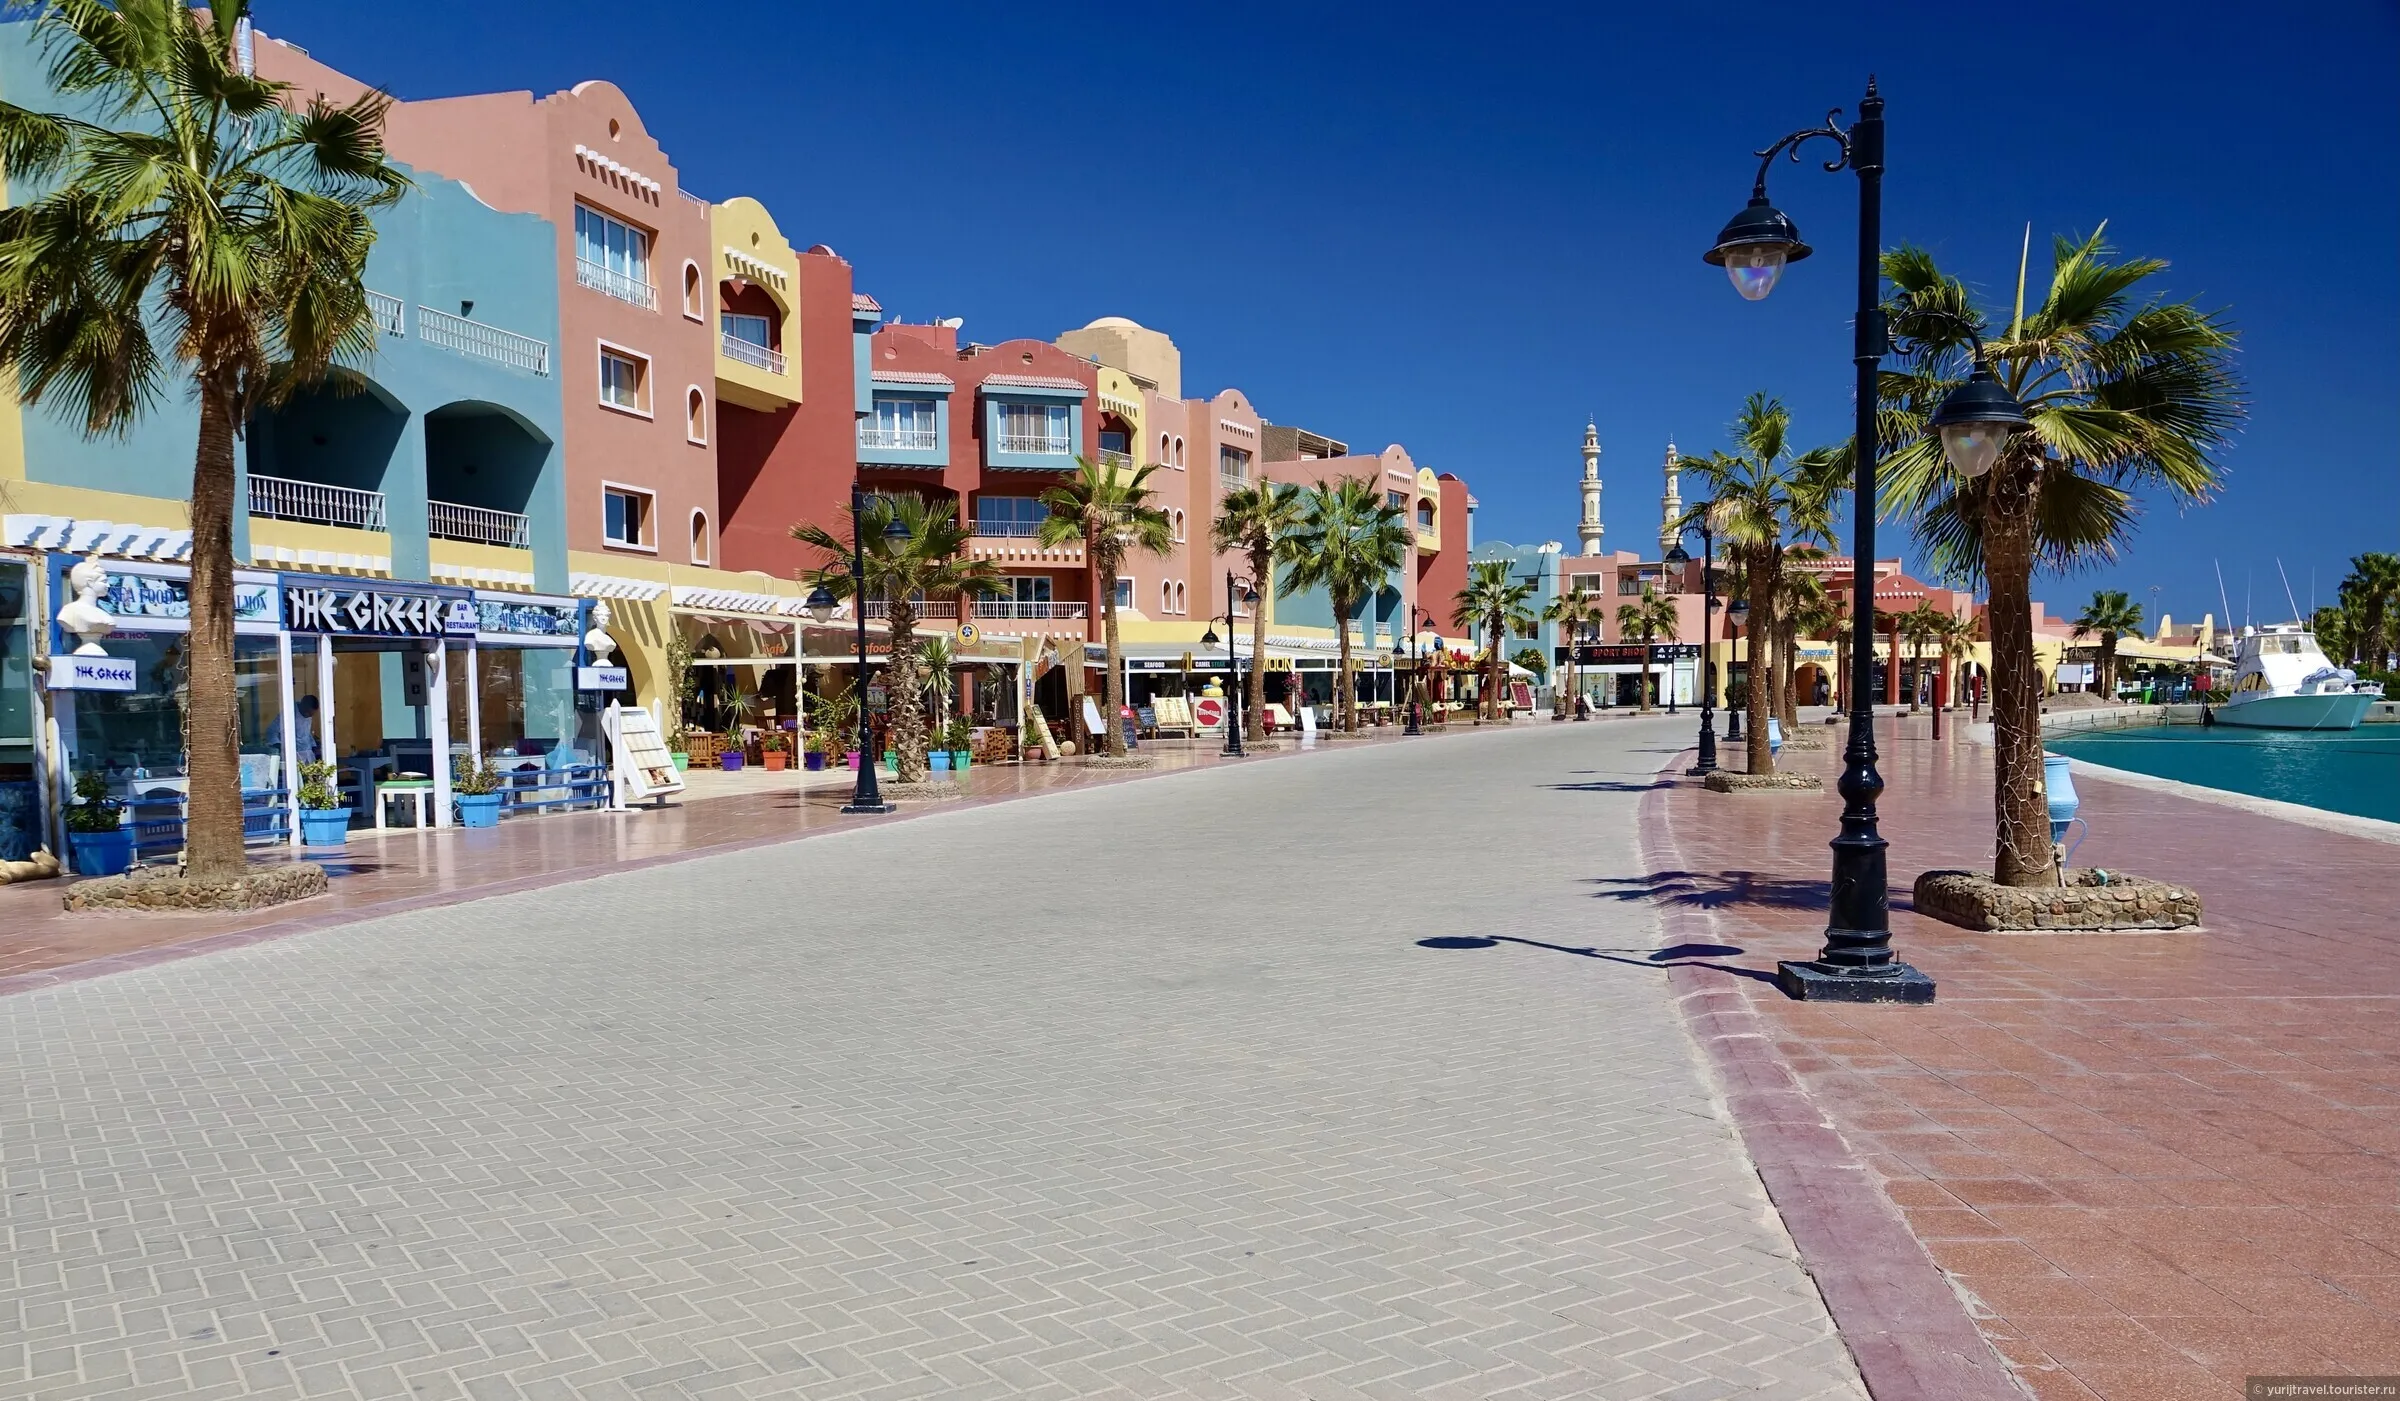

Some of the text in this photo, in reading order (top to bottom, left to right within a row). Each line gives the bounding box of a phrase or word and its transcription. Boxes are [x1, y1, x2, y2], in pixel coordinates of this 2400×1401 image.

[111, 586, 174, 605] SEA FOOD
[234, 595, 267, 610] LMON
[288, 587, 443, 634] THE GREEK
[456, 603, 468, 612] BAR
[446, 621, 480, 630] RESTAURANT
[850, 640, 893, 654] Sfood
[1592, 648, 1620, 658] SPORT
[1143, 661, 1165, 669] SEAFOOD
[1263, 656, 1292, 673] MOON
[97, 667, 132, 681] GREEK
[609, 674, 625, 683] GREEK
